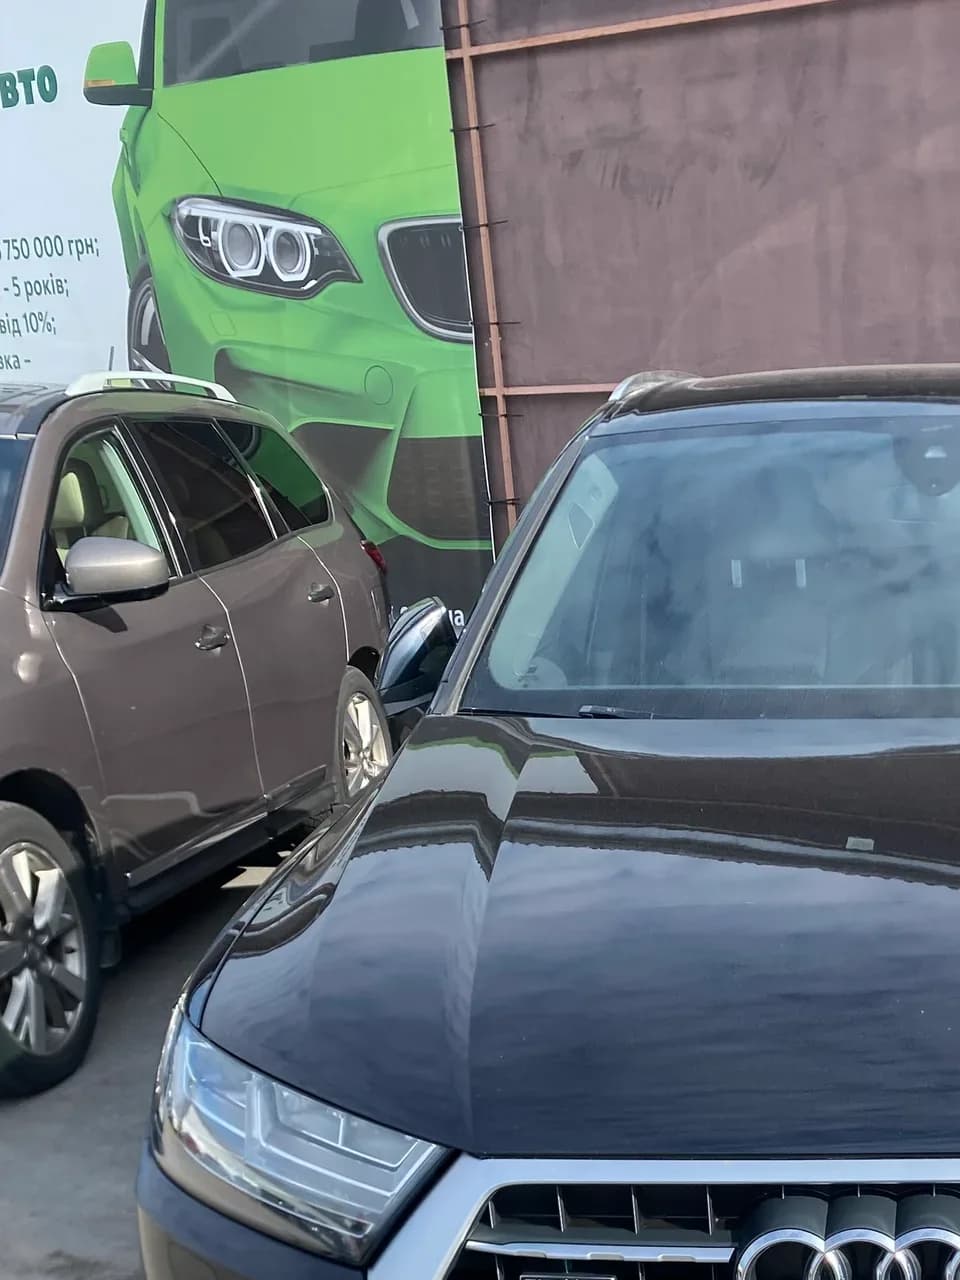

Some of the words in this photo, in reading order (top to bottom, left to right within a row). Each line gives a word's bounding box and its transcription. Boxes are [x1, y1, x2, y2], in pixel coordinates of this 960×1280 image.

[3, 237, 30, 260] 750
[33, 235, 64, 258] 000
[67, 237, 99, 262] грн;
[11, 276, 21, 297] 5
[23, 272, 69, 303] років;
[0, 312, 22, 336] від
[22, 311, 57, 335] 10%;
